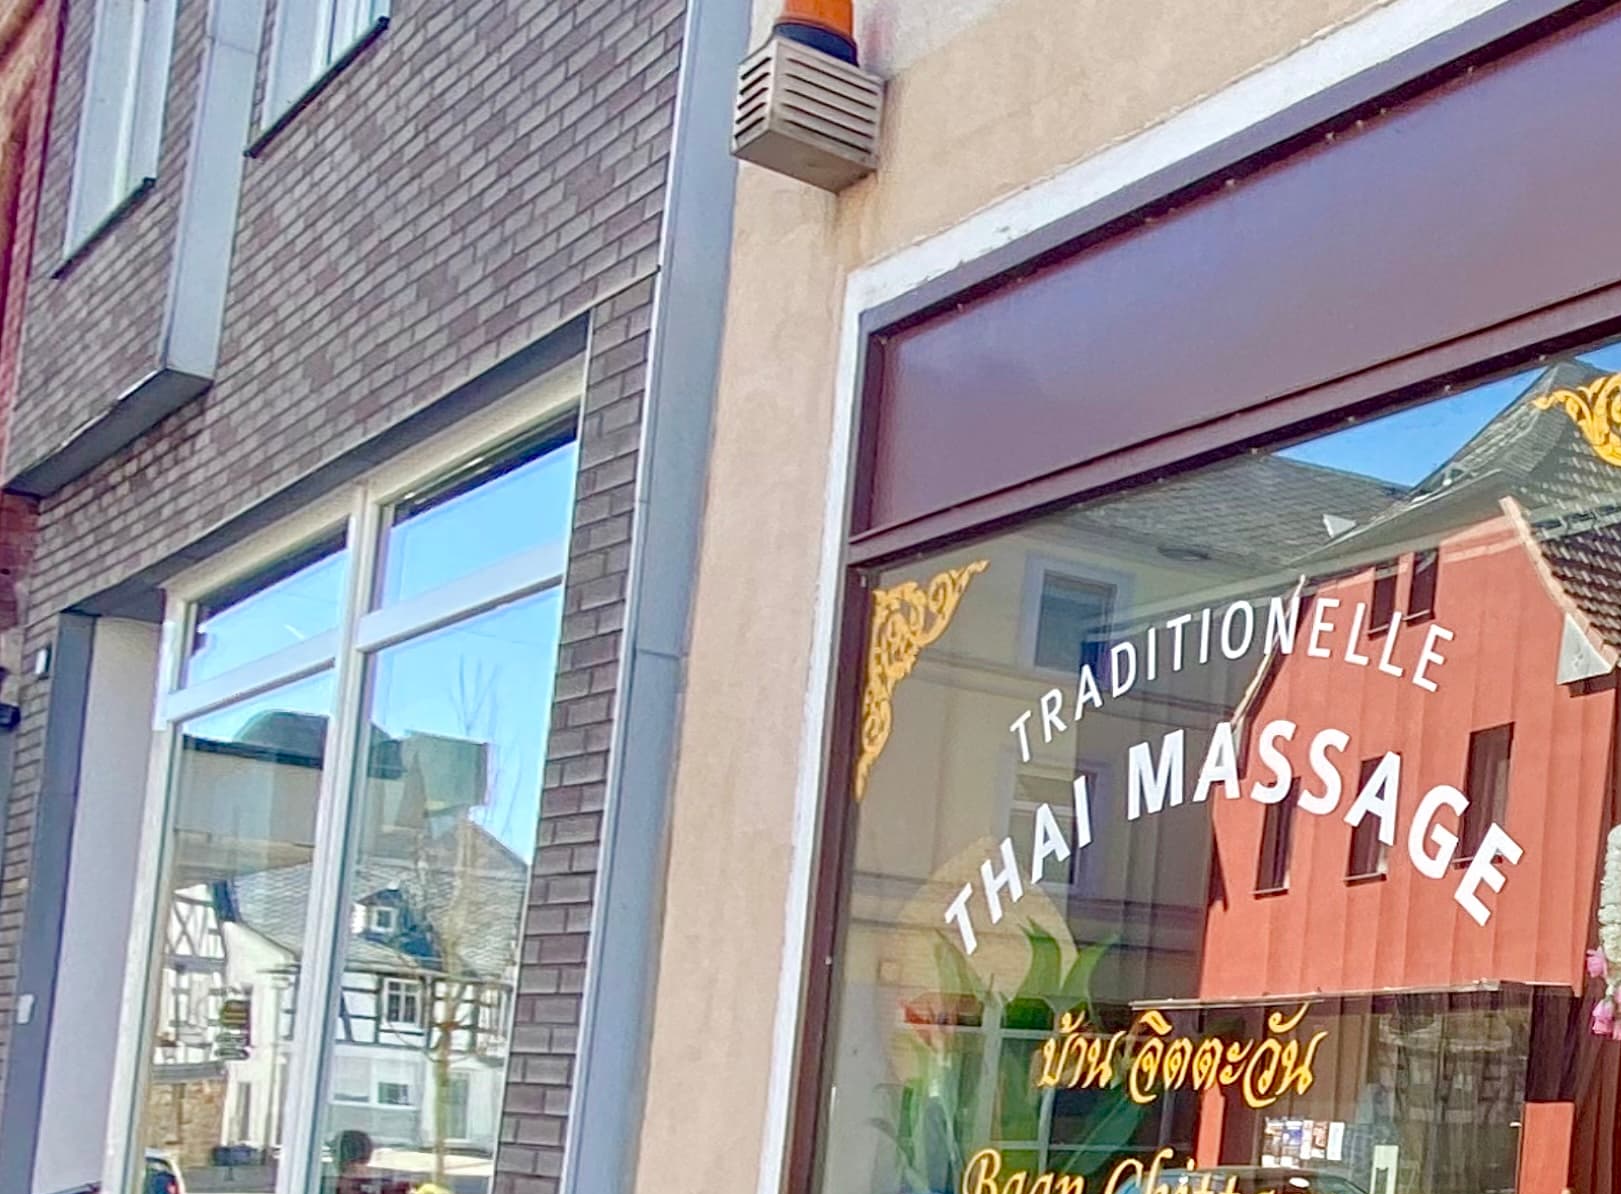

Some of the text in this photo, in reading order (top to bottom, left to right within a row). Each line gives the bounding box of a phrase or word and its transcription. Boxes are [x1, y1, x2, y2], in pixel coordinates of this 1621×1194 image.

[1009, 596, 1454, 763] TRADITIONELLE
[943, 718, 1524, 956] THAI MASSAGE
[1036, 1010, 1128, 1090] บ้าน
